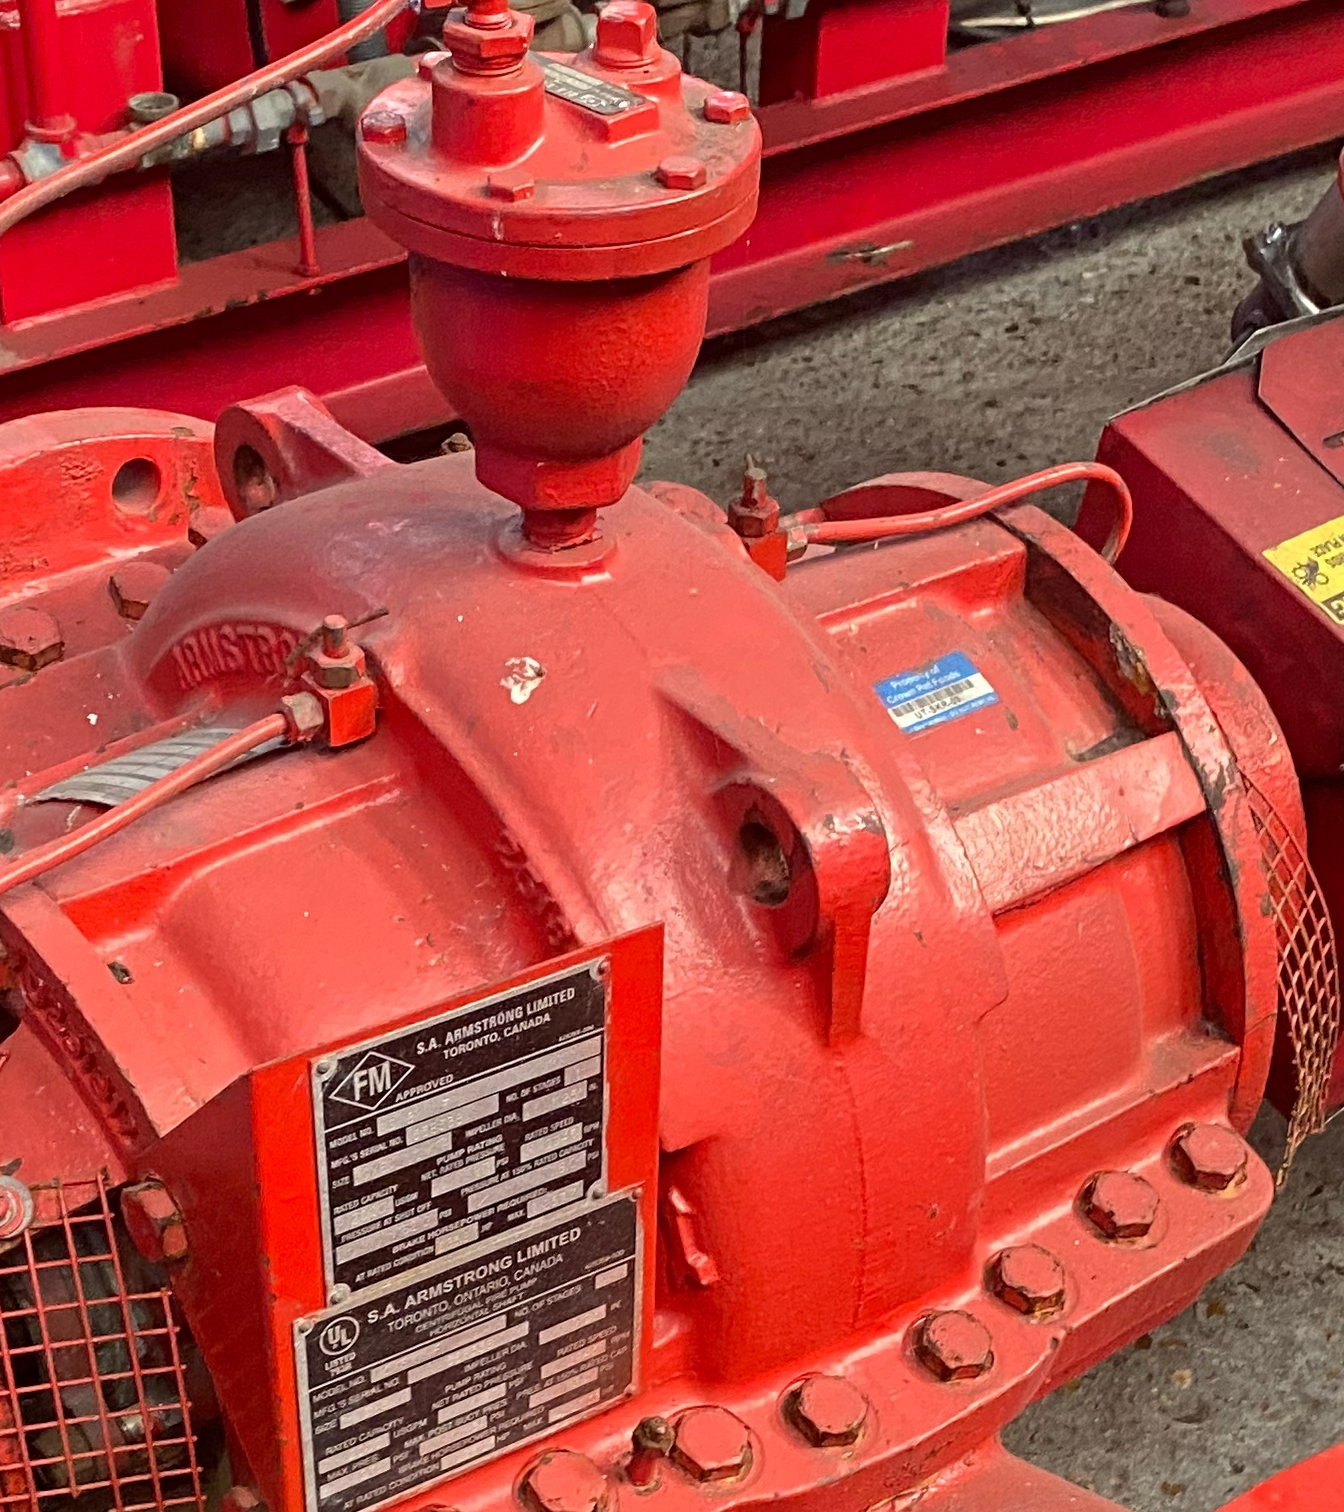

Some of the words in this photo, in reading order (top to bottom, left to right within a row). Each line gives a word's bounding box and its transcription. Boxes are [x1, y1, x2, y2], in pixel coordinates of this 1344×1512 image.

[416, 1034, 441, 1055] S.A.
[445, 1004, 523, 1045] ARMSTRONG
[526, 986, 574, 1015] LIMITED
[443, 1029, 500, 1060] TORONTO,
[503, 1011, 551, 1038] CANADA
[353, 1059, 391, 1102] FM
[395, 1073, 453, 1102] APPROVED
[549, 1115, 573, 1132] SPEED
[436, 1148, 465, 1166] PUMP
[466, 1133, 502, 1154] RATING
[333, 1198, 359, 1215] RATED
[360, 1183, 398, 1205] CAPACITY
[416, 1200, 432, 1214] OFF
[392, 1234, 425, 1254] BRAKE
[427, 1206, 494, 1240] HORSEPOWER
[367, 1299, 399, 1324] S.A.
[404, 1253, 512, 1309] ARMSTRONG
[517, 1225, 580, 1263] LIMITED
[387, 1297, 451, 1334] TORONTO,
[453, 1273, 511, 1306] ONTARIO,
[514, 1251, 563, 1281] CANADA
[414, 1298, 483, 1334] CENTRIFUGAL
[485, 1288, 508, 1304] FIRE
[508, 1275, 537, 1295] PUMP
[429, 1305, 489, 1337] HORIZONTAL
[492, 1290, 525, 1311] SHAFT
[531, 1299, 545, 1312] OF
[545, 1283, 582, 1306] STAGES
[327, 1320, 351, 1351] UL
[556, 1337, 586, 1357] RATED
[587, 1323, 617, 1344] SPEED
[324, 1350, 356, 1371] LISTED
[444, 1375, 471, 1394] PUMP
[473, 1360, 506, 1382] RATING
[312, 1382, 346, 1403] MODEL
[451, 1381, 482, 1402] RATED
[483, 1360, 533, 1389] PRESSURE
[325, 1435, 356, 1456] RATED
[358, 1415, 404, 1442] CAPACITY
[355, 1484, 386, 1505] RATED
[388, 1461, 439, 1490] CONDITION
